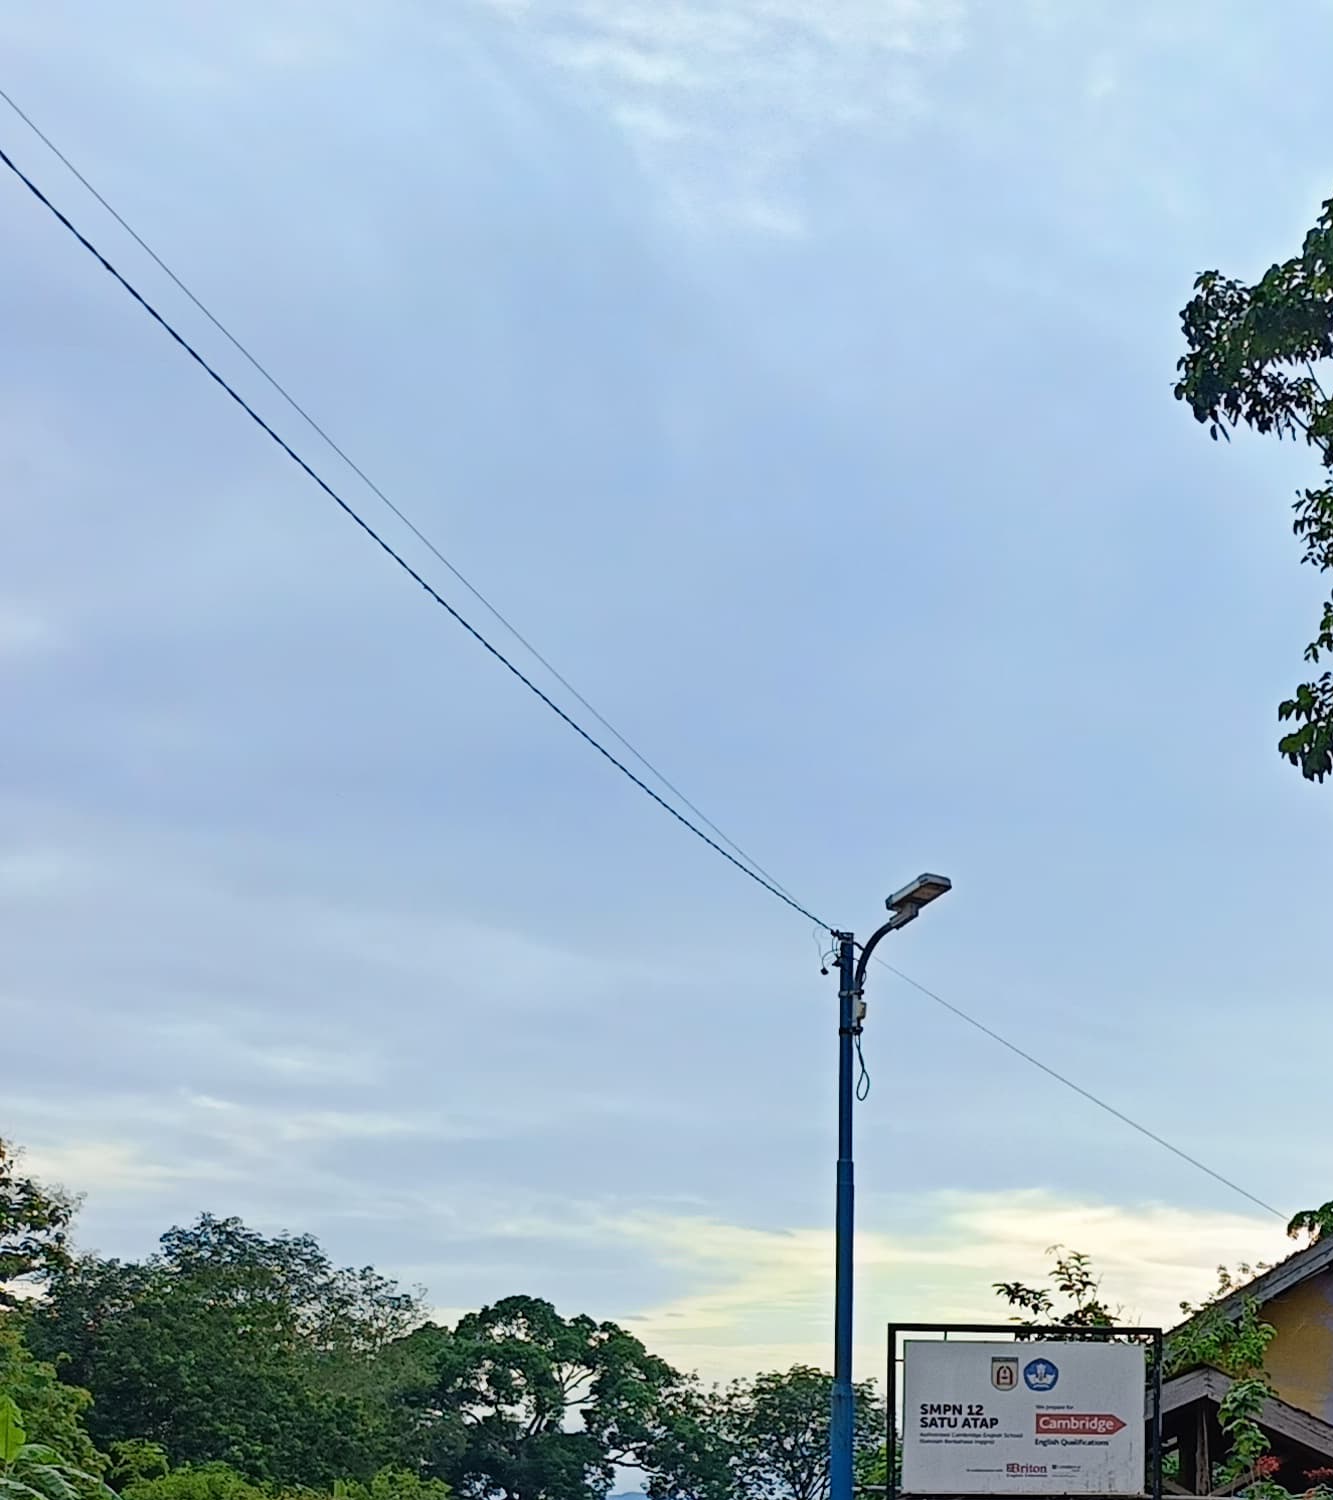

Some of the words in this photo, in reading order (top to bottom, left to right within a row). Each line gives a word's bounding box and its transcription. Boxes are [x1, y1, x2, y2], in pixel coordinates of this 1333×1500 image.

[920, 1404, 962, 1415] SMPN
[967, 1404, 984, 1416] 12
[920, 1417, 957, 1428] SATU
[961, 1417, 999, 1429] ATAP
[1039, 1417, 1114, 1433] Cambridge
[1035, 1439, 1059, 1447] English
[1061, 1439, 1109, 1447] Qualifications
